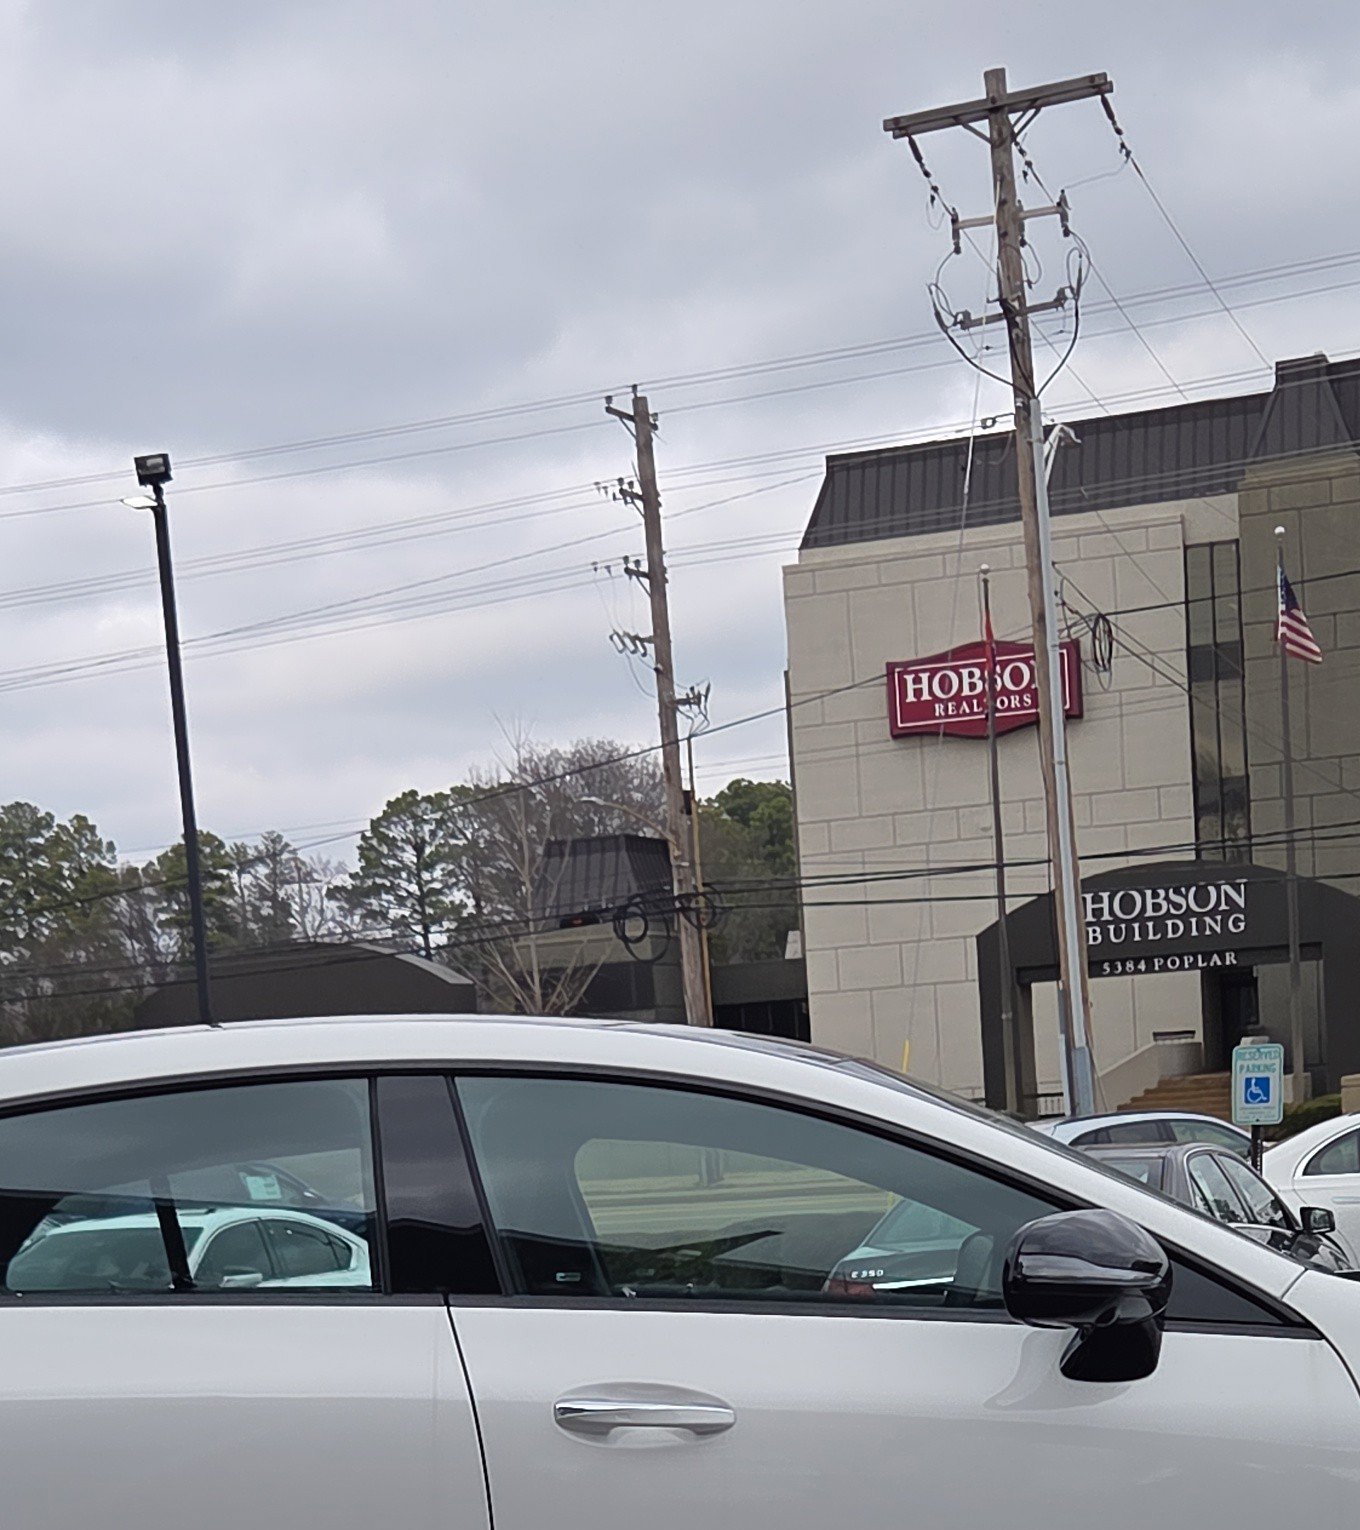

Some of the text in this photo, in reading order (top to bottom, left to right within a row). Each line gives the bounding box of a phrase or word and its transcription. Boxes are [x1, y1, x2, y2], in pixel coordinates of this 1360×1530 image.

[903, 660, 1038, 703] HOBSO
[934, 693, 1033, 717] REALORS
[1082, 878, 1249, 922] HOBSON
[1086, 913, 1246, 945] BUILDING
[1102, 951, 1238, 976] 5384 POPLAR
[1238, 1062, 1277, 1074] PARKING
